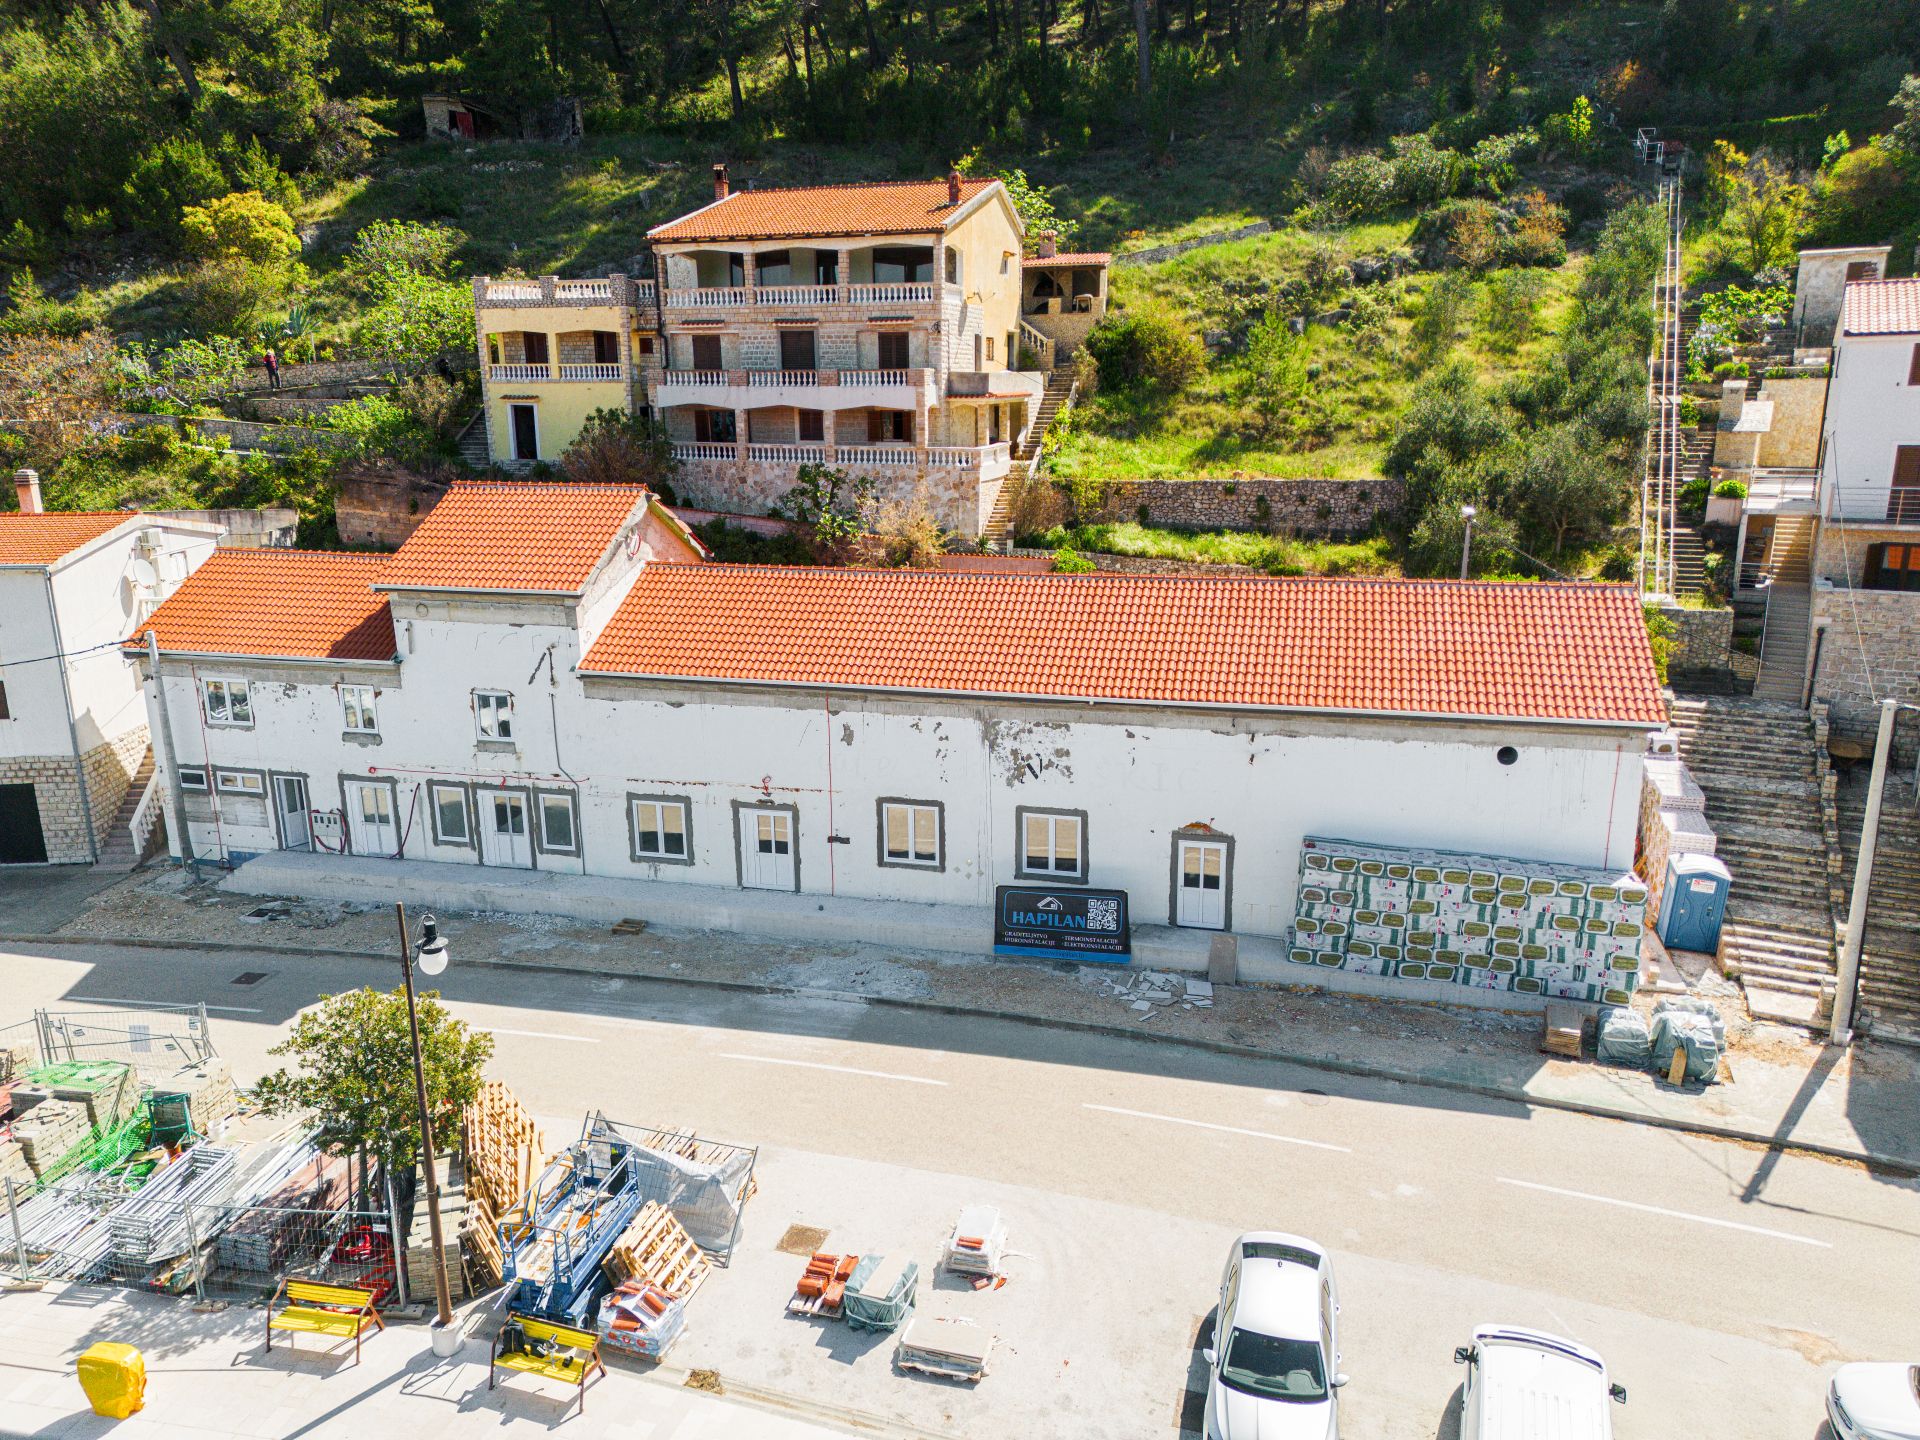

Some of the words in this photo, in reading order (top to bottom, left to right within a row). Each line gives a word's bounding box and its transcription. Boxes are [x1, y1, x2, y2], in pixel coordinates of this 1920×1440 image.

[1012, 911, 1086, 929] HAPILAN
[1004, 931, 1048, 939] GRADITELJSTVO
[1064, 935, 1119, 945] TERMOINSTALACIJE
[1063, 942, 1123, 951] ELEKTROINSTALACIJE
